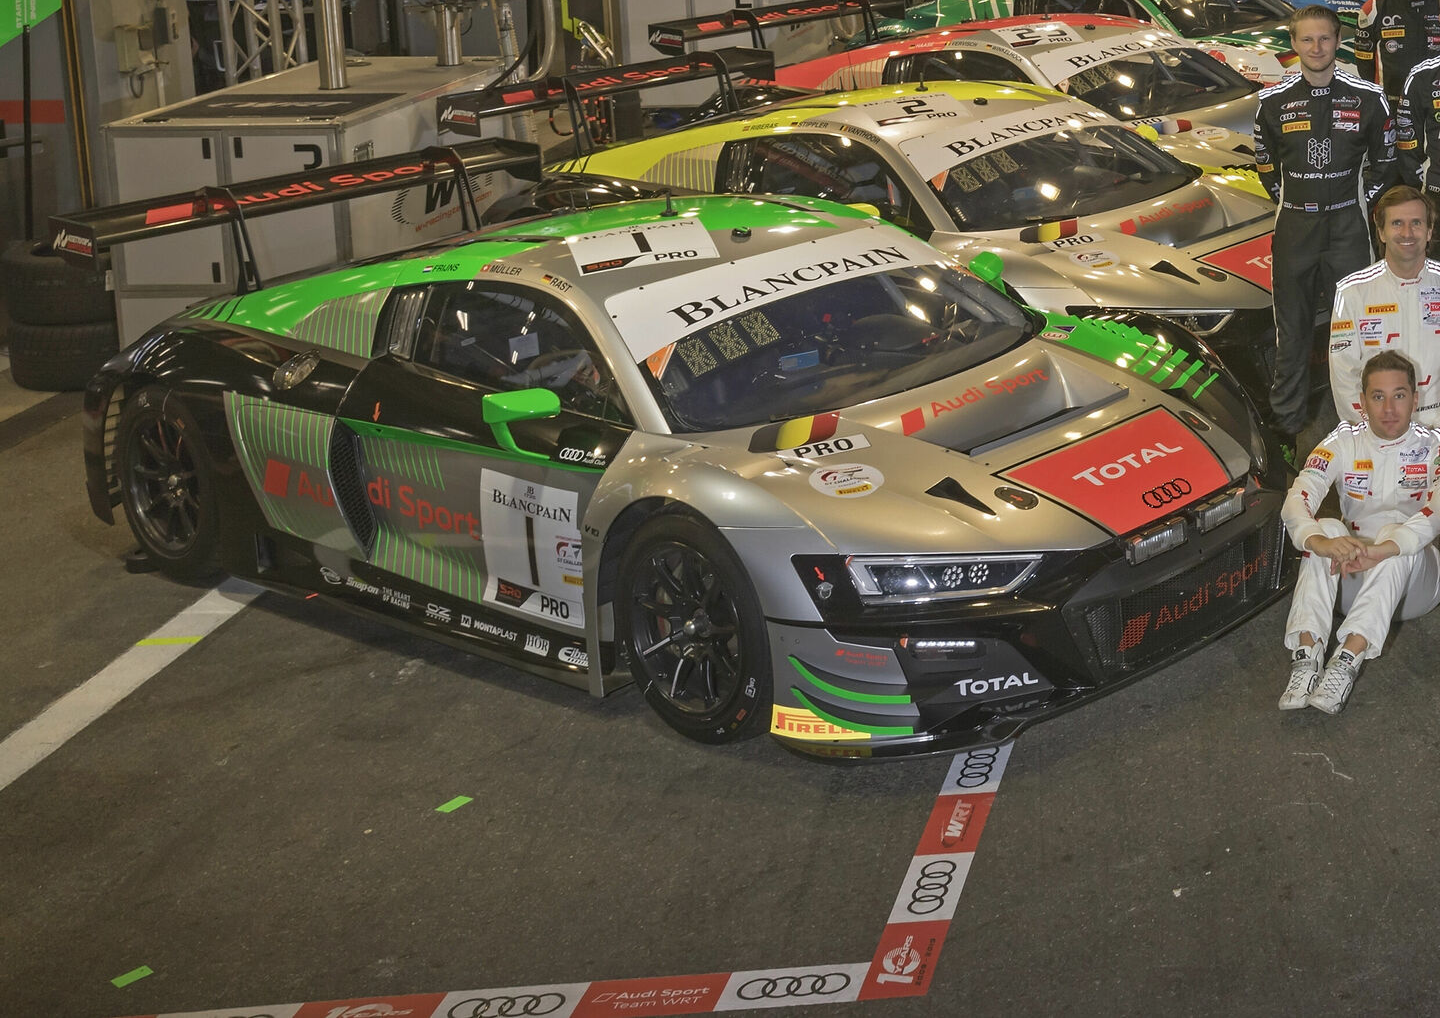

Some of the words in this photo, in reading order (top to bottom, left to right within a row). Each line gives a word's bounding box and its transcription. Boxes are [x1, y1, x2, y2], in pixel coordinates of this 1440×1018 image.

[899, 99, 934, 115] 2
[927, 111, 957, 119] PRO
[798, 121, 829, 129] STIPPLER
[942, 109, 1102, 158] BLANCPAIN
[1138, 207, 1172, 226] Audi
[1175, 196, 1216, 218] Sport
[631, 232, 651, 253] 1
[1054, 235, 1094, 249] PRO
[655, 250, 698, 261] PRO
[491, 264, 522, 276] MÜLLER
[550, 277, 573, 293] RAST
[667, 246, 911, 328] BLANCPAIN
[1368, 305, 1397, 314] PIRELLI
[931, 387, 986, 419] Audi
[989, 368, 1050, 398] Sport
[793, 437, 853, 458] PRO
[1073, 442, 1184, 487] TOTAL
[400, 487, 482, 541] Sport
[492, 489, 572, 523] BLANCPAIN
[525, 516, 540, 587] 1
[346, 576, 379, 595] Snap-on
[1153, 590, 1211, 632] Audi
[1214, 551, 1268, 604] Sport
[540, 595, 570, 620] PRO
[474, 620, 518, 642] MONTAPLAST
[954, 672, 1039, 697] TOTAL
[777, 711, 860, 734] PIRELL
[612, 998, 661, 1010] Team
[664, 996, 701, 1008] WRT
[618, 989, 658, 1000] Audi
[660, 986, 711, 999] Sport
